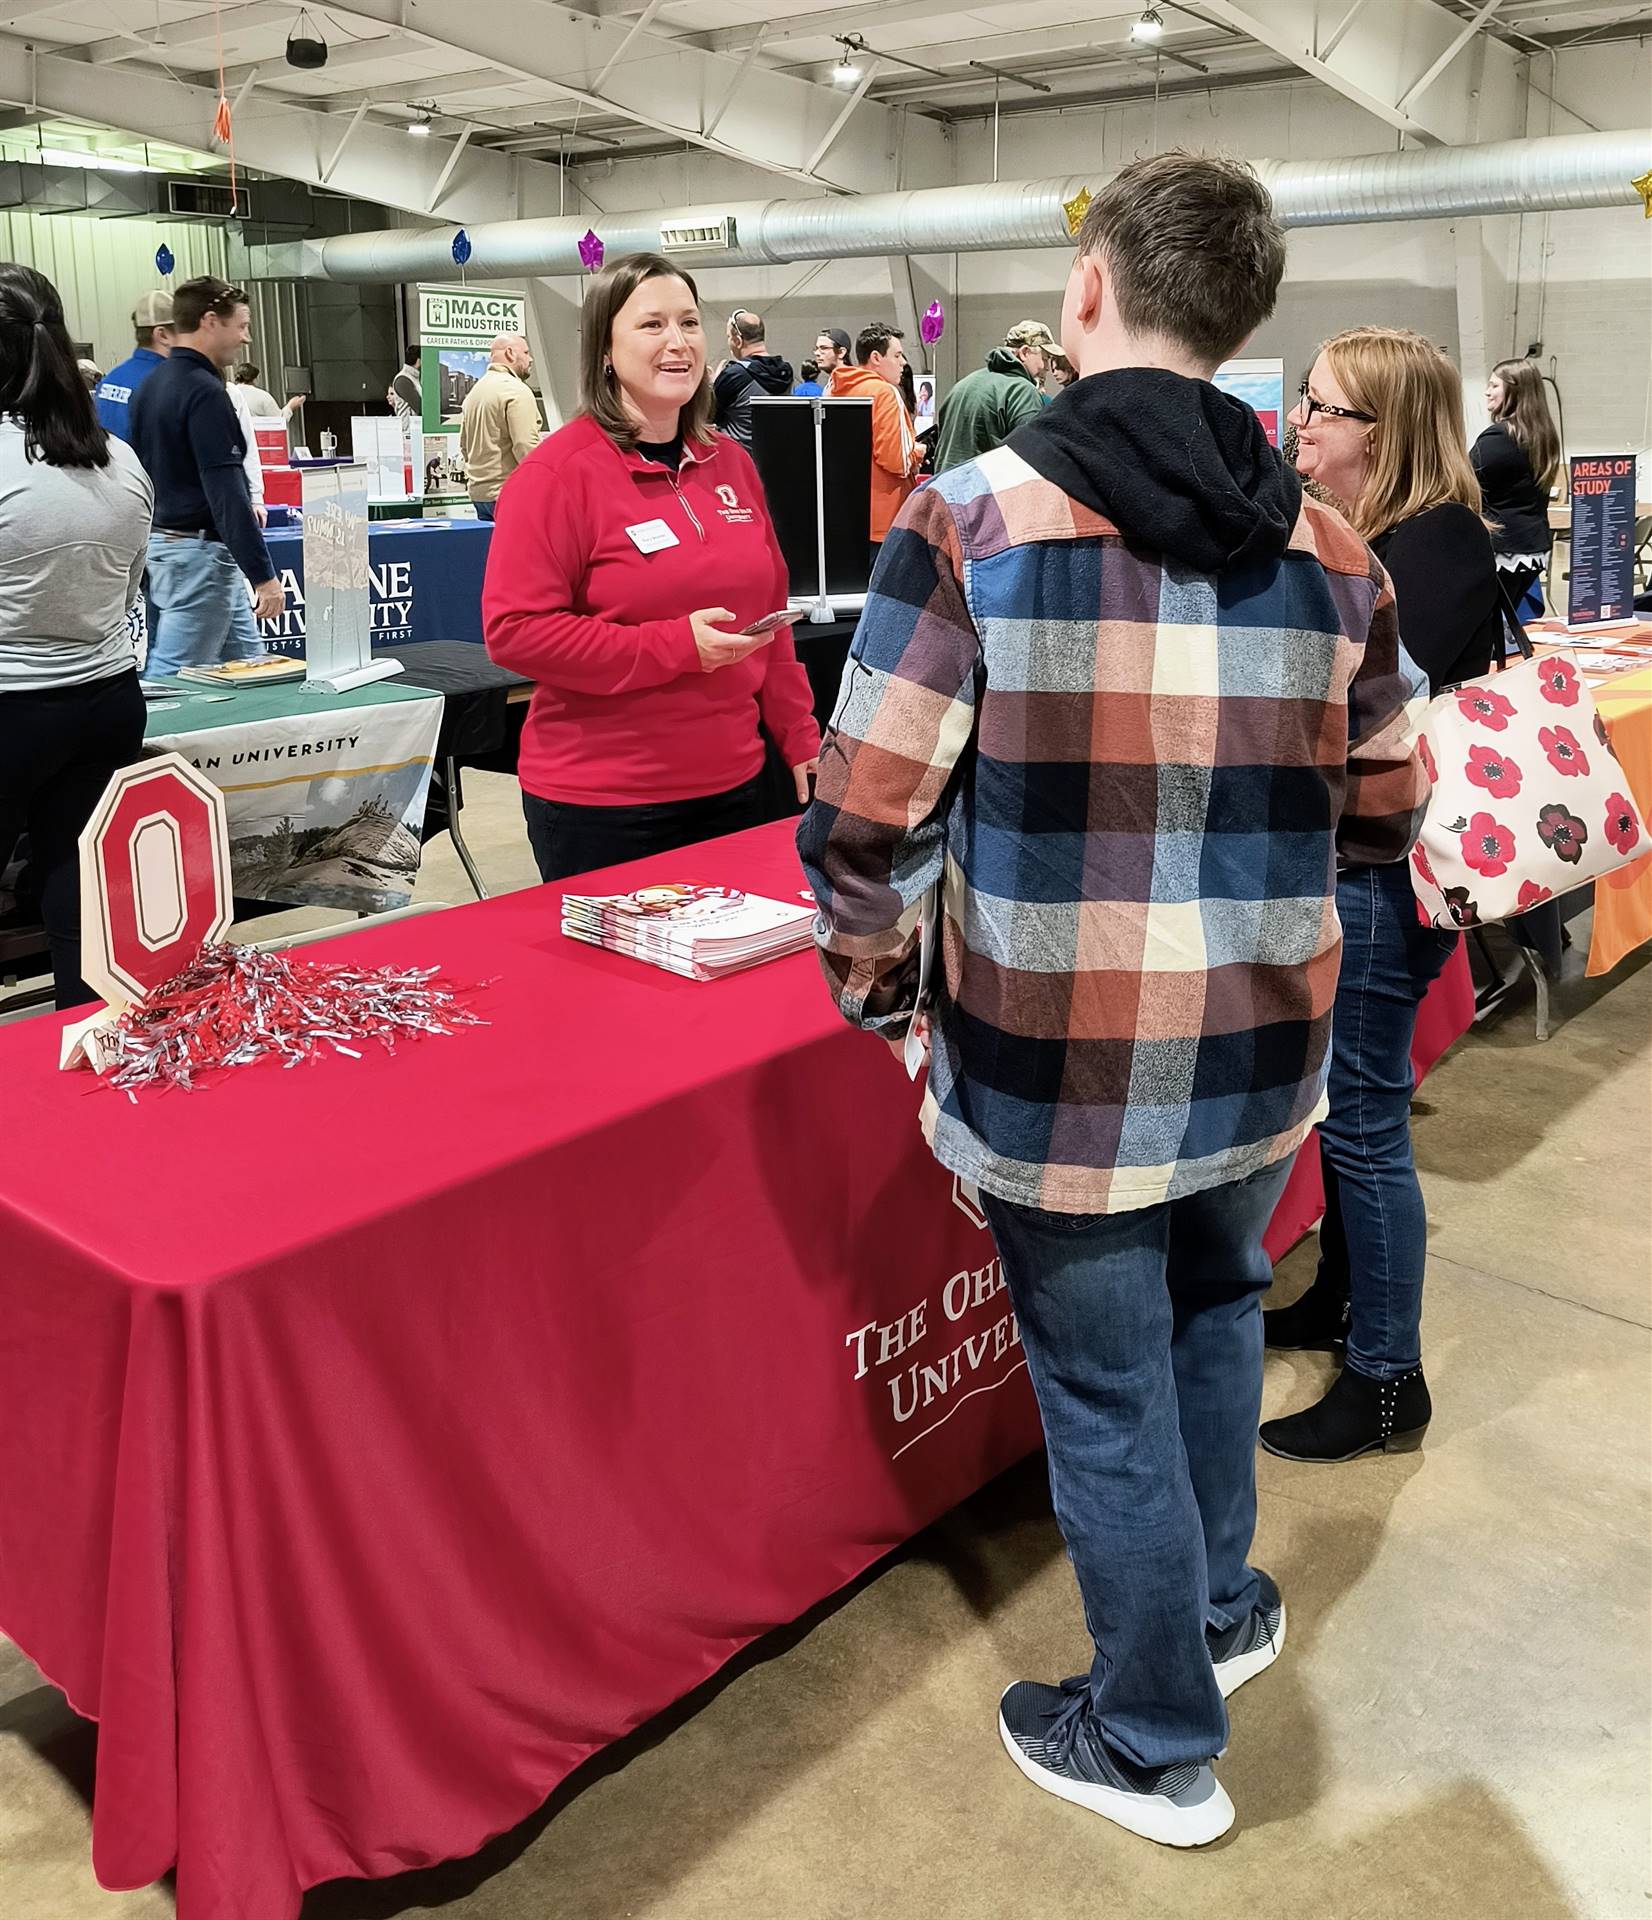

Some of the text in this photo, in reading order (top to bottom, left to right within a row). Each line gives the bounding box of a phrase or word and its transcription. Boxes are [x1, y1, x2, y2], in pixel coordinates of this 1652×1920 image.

[452, 300, 518, 318] MACK
[452, 318, 519, 331] INDUSTRIES
[427, 337, 450, 345] CAREER
[450, 338, 469, 346] PATHS
[1574, 460, 1632, 478] AREAS OF
[1573, 480, 1611, 496] STUDY
[378, 629, 413, 640] FIRST
[232, 735, 360, 765] UNIVERSITY
[845, 1257, 1008, 1380] THE OHI
[887, 1311, 1022, 1422] UNIVE
